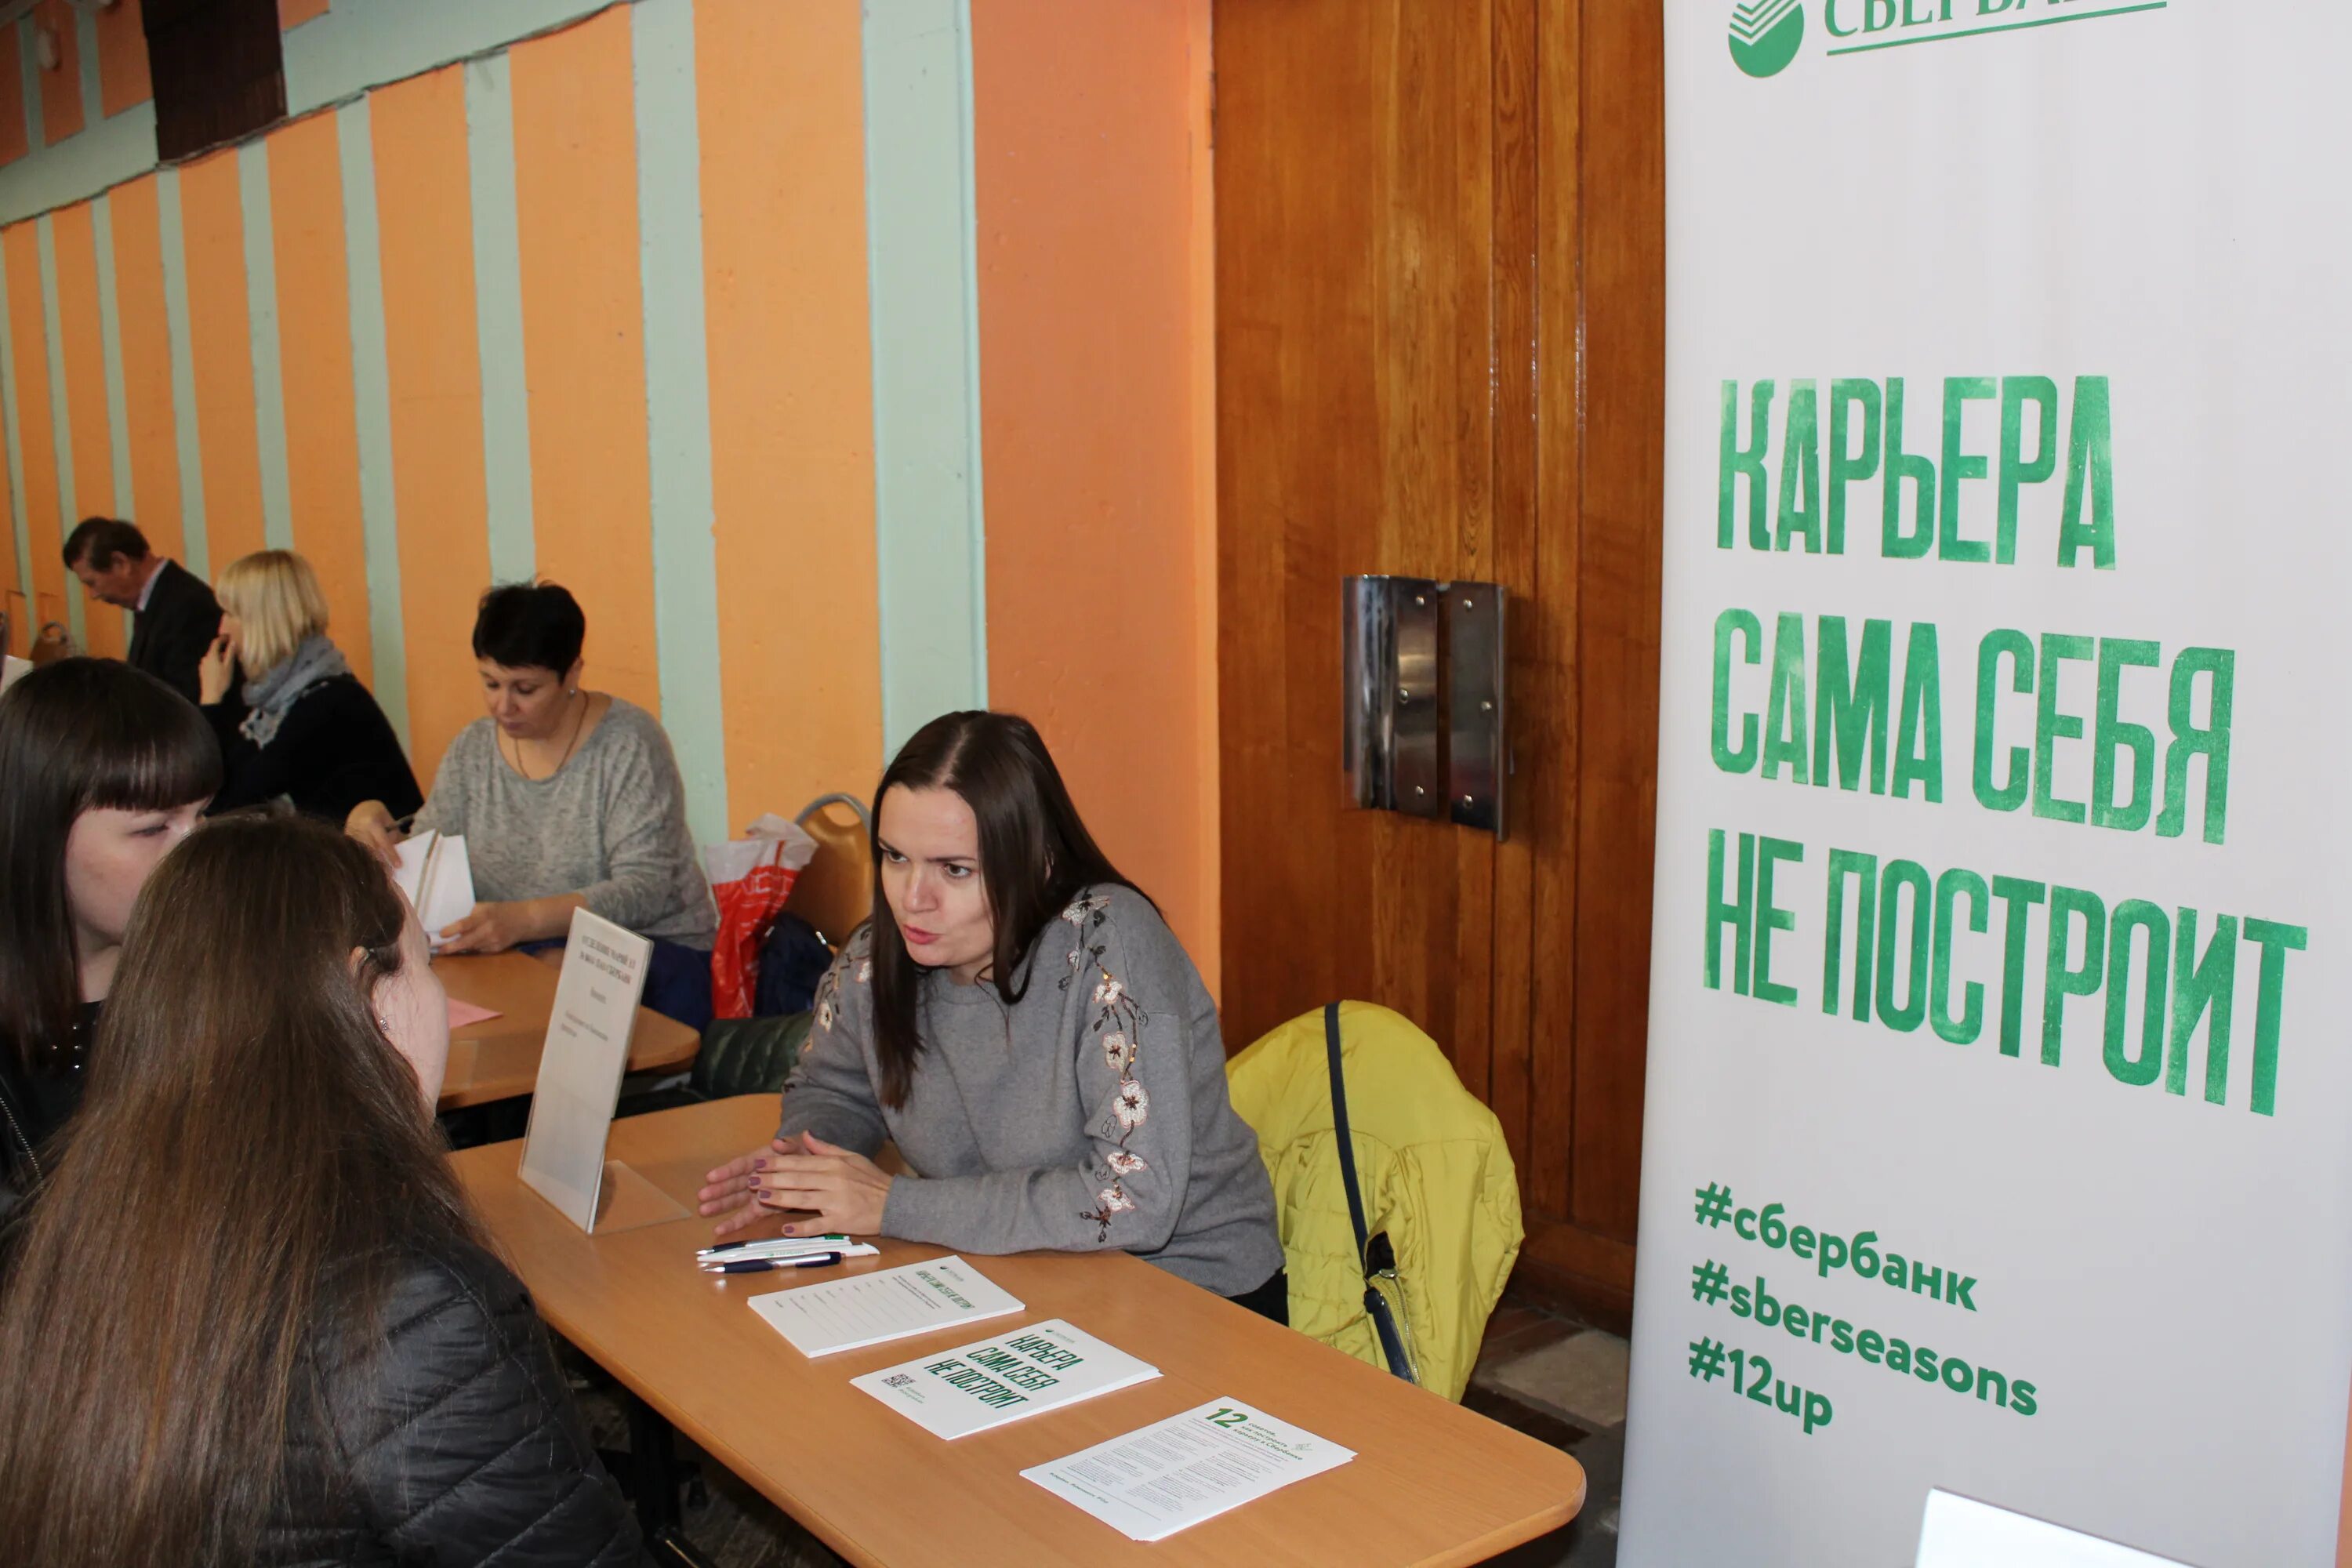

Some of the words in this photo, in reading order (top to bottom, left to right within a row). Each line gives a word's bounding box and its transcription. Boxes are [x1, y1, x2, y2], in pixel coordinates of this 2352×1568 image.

[1718, 375, 2118, 570] КАРЬЕРА
[1711, 608, 1945, 804] САМА
[1973, 627, 2236, 846] СЕБЯ
[1704, 828, 1806, 1009] НЕ
[1822, 848, 2310, 1118] ПОСТРОИТ
[1695, 1181, 1977, 1312] #сбербанк
[924, 1359, 966, 1375] НЕ
[966, 1347, 1024, 1373] САМА
[1003, 1365, 1060, 1392] СЕБЯ
[1005, 1334, 1083, 1370] КАРЬЕРА
[1689, 1336, 1835, 1436] #12up
[1692, 1258, 2038, 1417] #sberseasons
[941, 1368, 1029, 1409] ПОСТРОИТ
[1205, 1408, 1248, 1428] 12
